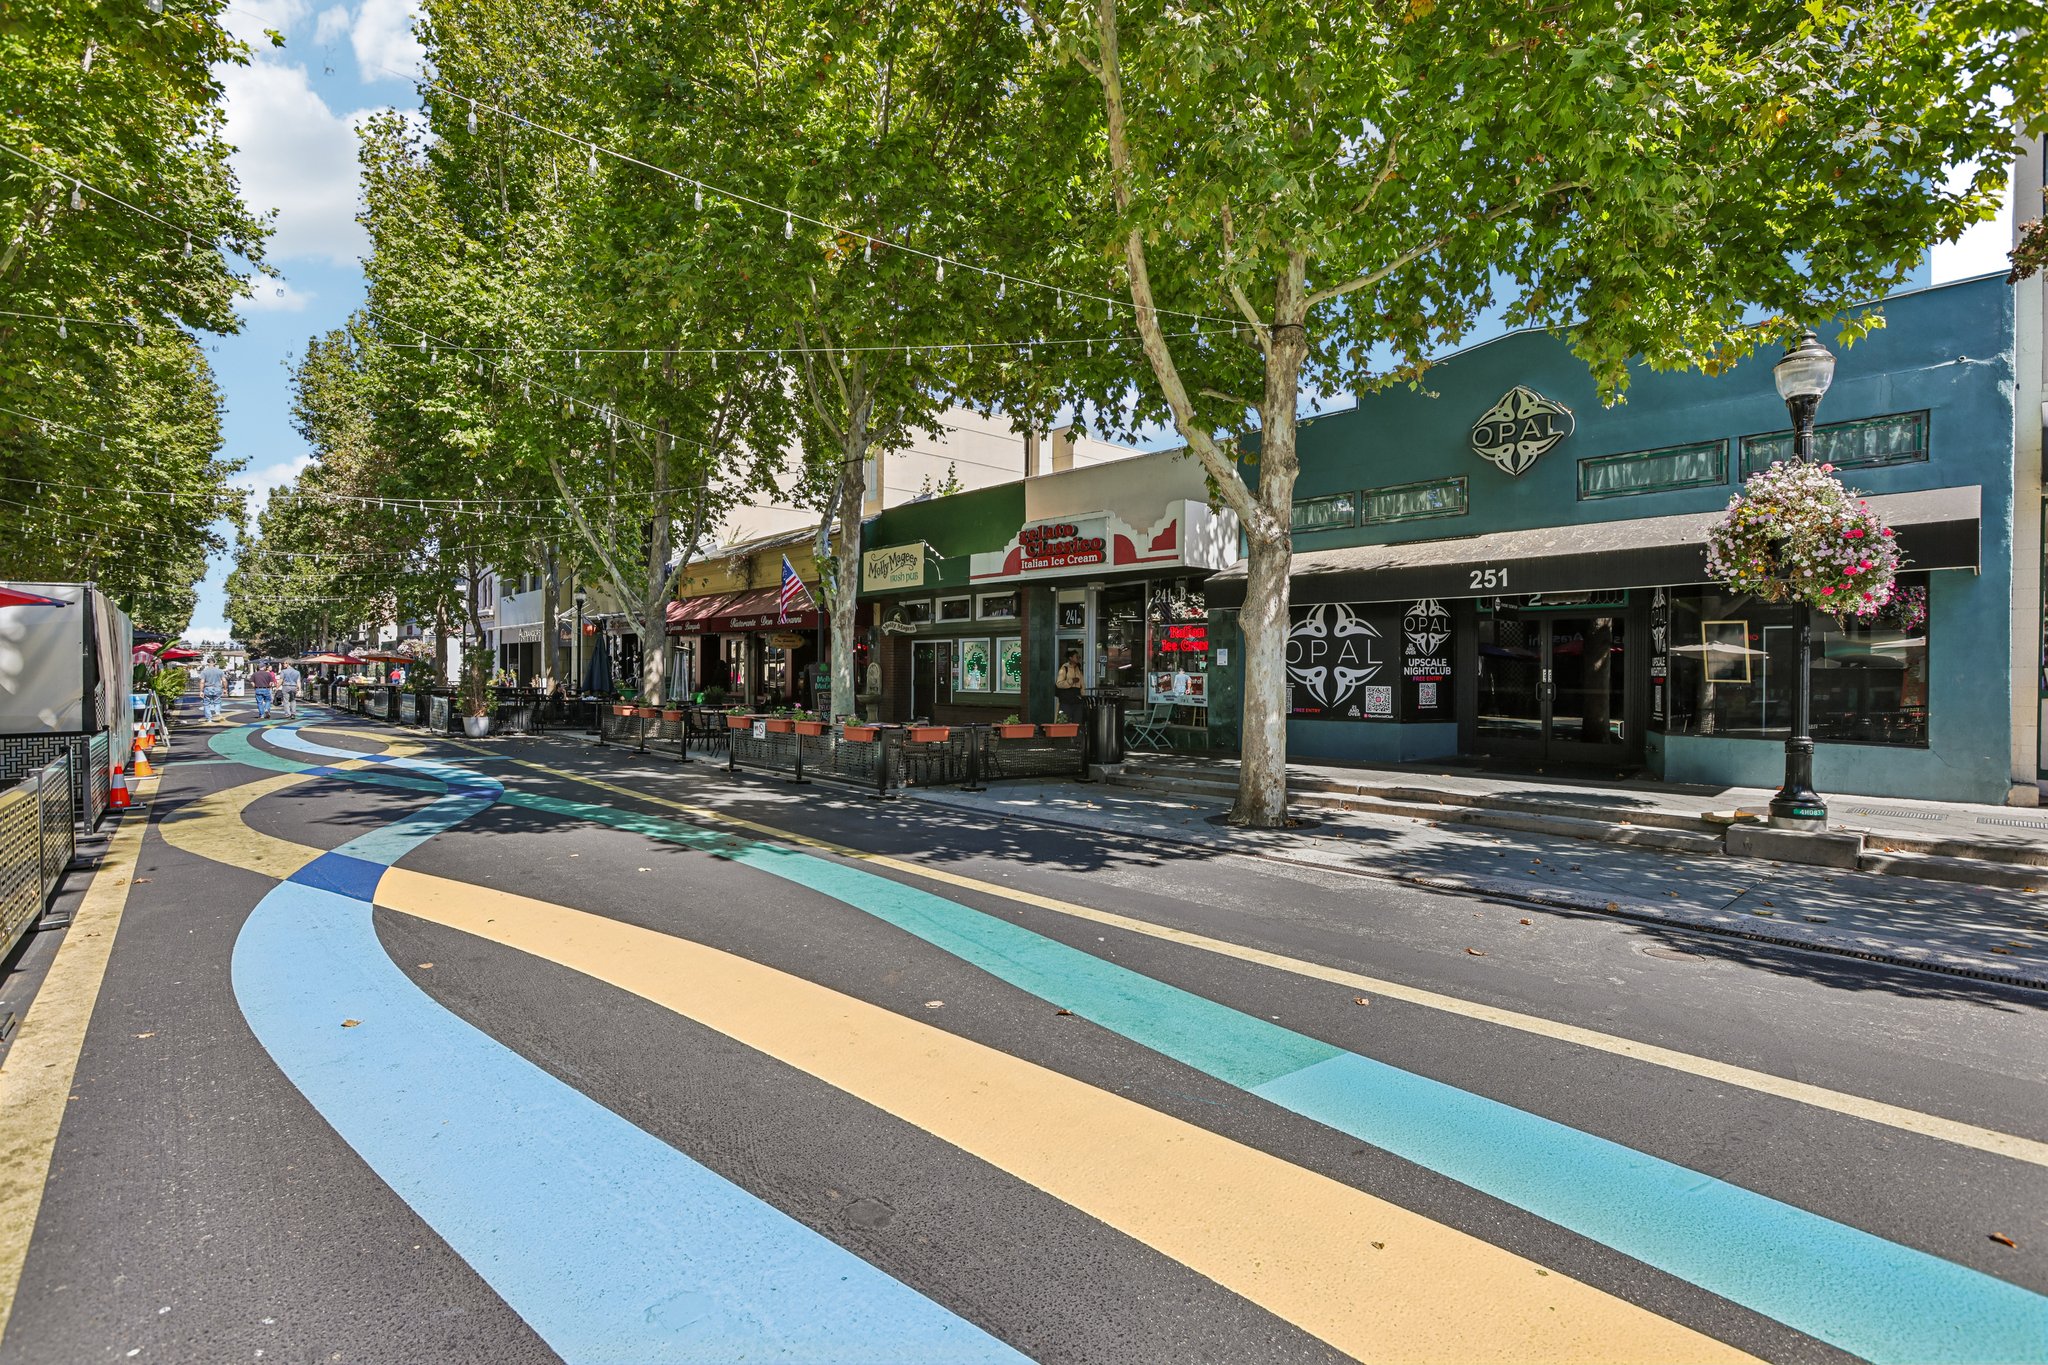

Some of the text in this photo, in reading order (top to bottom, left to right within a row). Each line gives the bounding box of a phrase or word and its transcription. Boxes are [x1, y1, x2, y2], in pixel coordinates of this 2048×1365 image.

[1472, 415, 1564, 447] OPAL
[868, 552, 918, 579] Molly Magees
[1021, 554, 1098, 569] Italian Ice Cream
[1469, 567, 1509, 589] 251
[1155, 586, 1187, 603] 241 B
[760, 615, 773, 626] Don
[1403, 617, 1452, 632] OPAL
[1286, 639, 1383, 664] OPAL
[1408, 658, 1448, 667] UPSCALE
[1403, 667, 1452, 675] NIGHTCLUB
